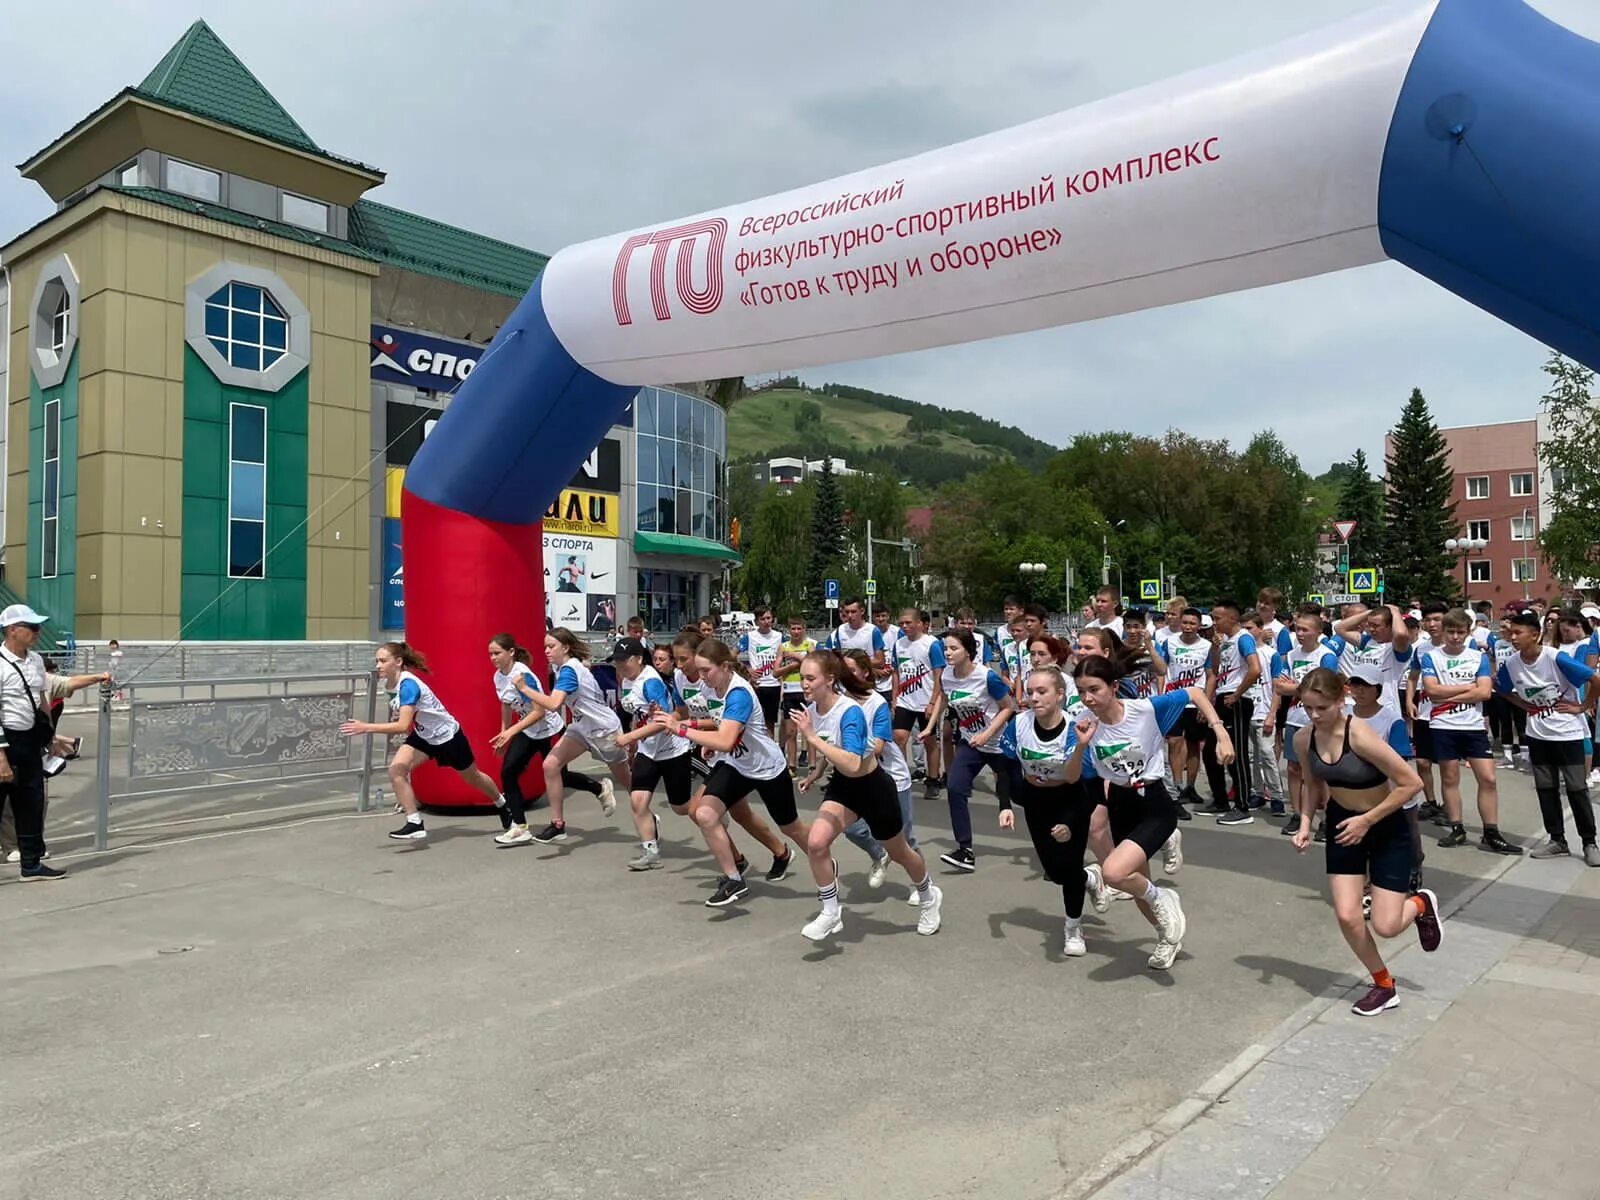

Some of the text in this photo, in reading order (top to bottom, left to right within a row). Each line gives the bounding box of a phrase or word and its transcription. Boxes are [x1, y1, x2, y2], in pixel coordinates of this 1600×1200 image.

[734, 137, 1220, 277] физкультурно-спортивный комплекс
[738, 179, 904, 237] Всероссийский
[612, 217, 728, 326] ГТО
[740, 227, 1062, 307] «Готов к труду и обороне»
[551, 538, 594, 551] СПОРТА
[829, 581, 837, 596] P
